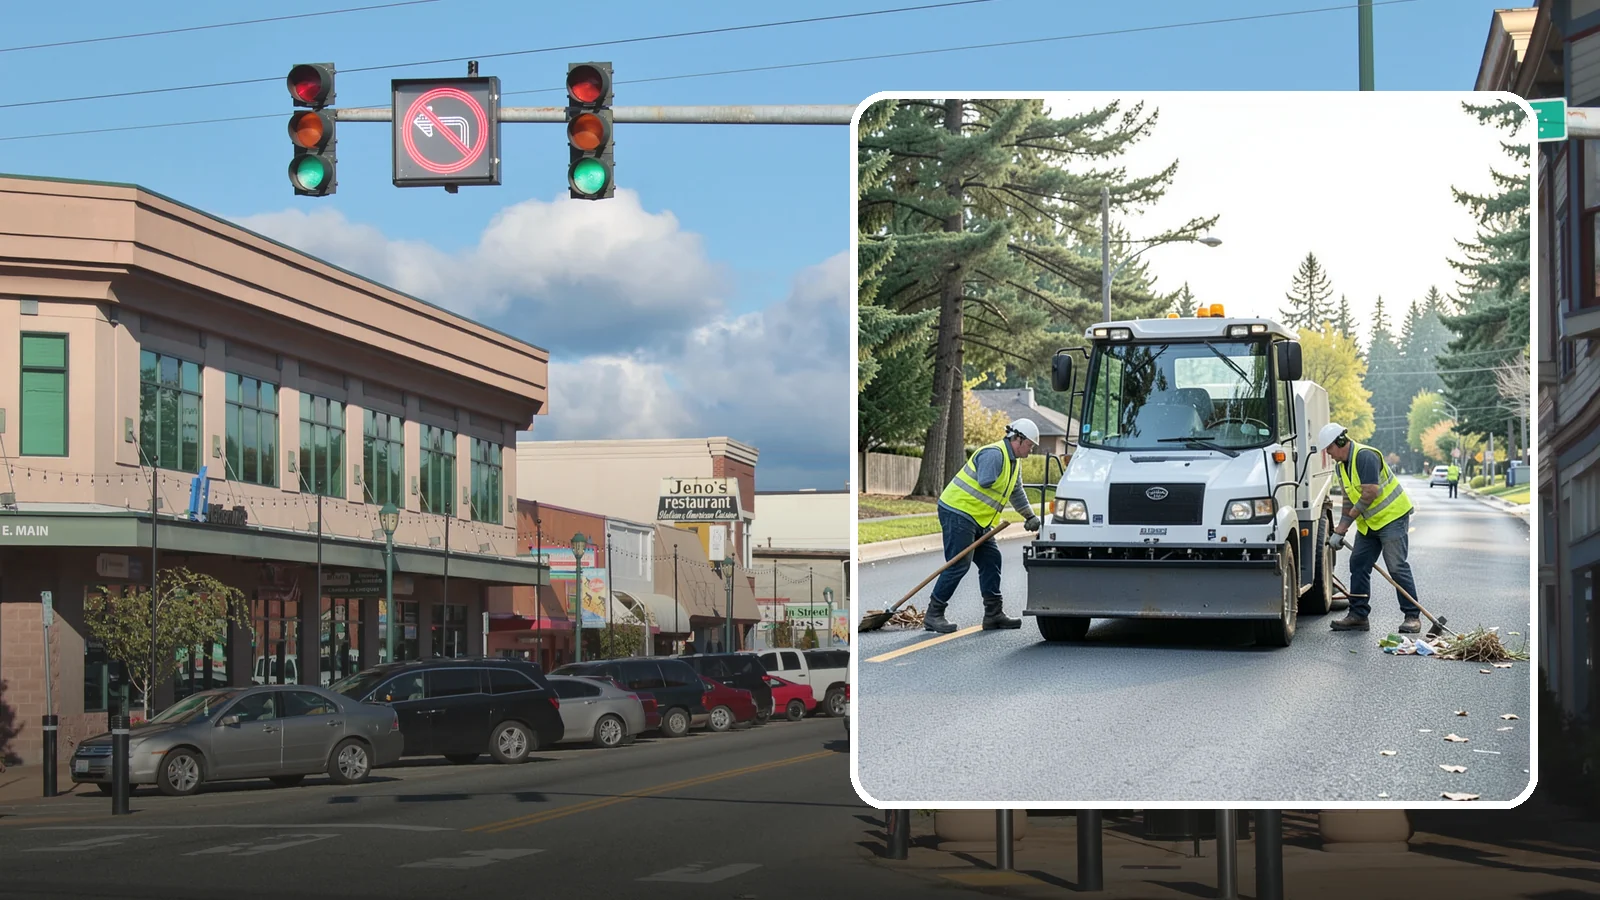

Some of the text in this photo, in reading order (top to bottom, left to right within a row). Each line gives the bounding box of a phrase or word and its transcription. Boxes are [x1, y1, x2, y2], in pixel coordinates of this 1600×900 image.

[669, 479, 728, 495] Jeno's
[665, 496, 731, 509] restaurant
[686, 509, 714, 520] American
[715, 509, 738, 520] Cuisine
[2, 525, 49, 537] E. MAIN
[797, 607, 829, 617] Street
